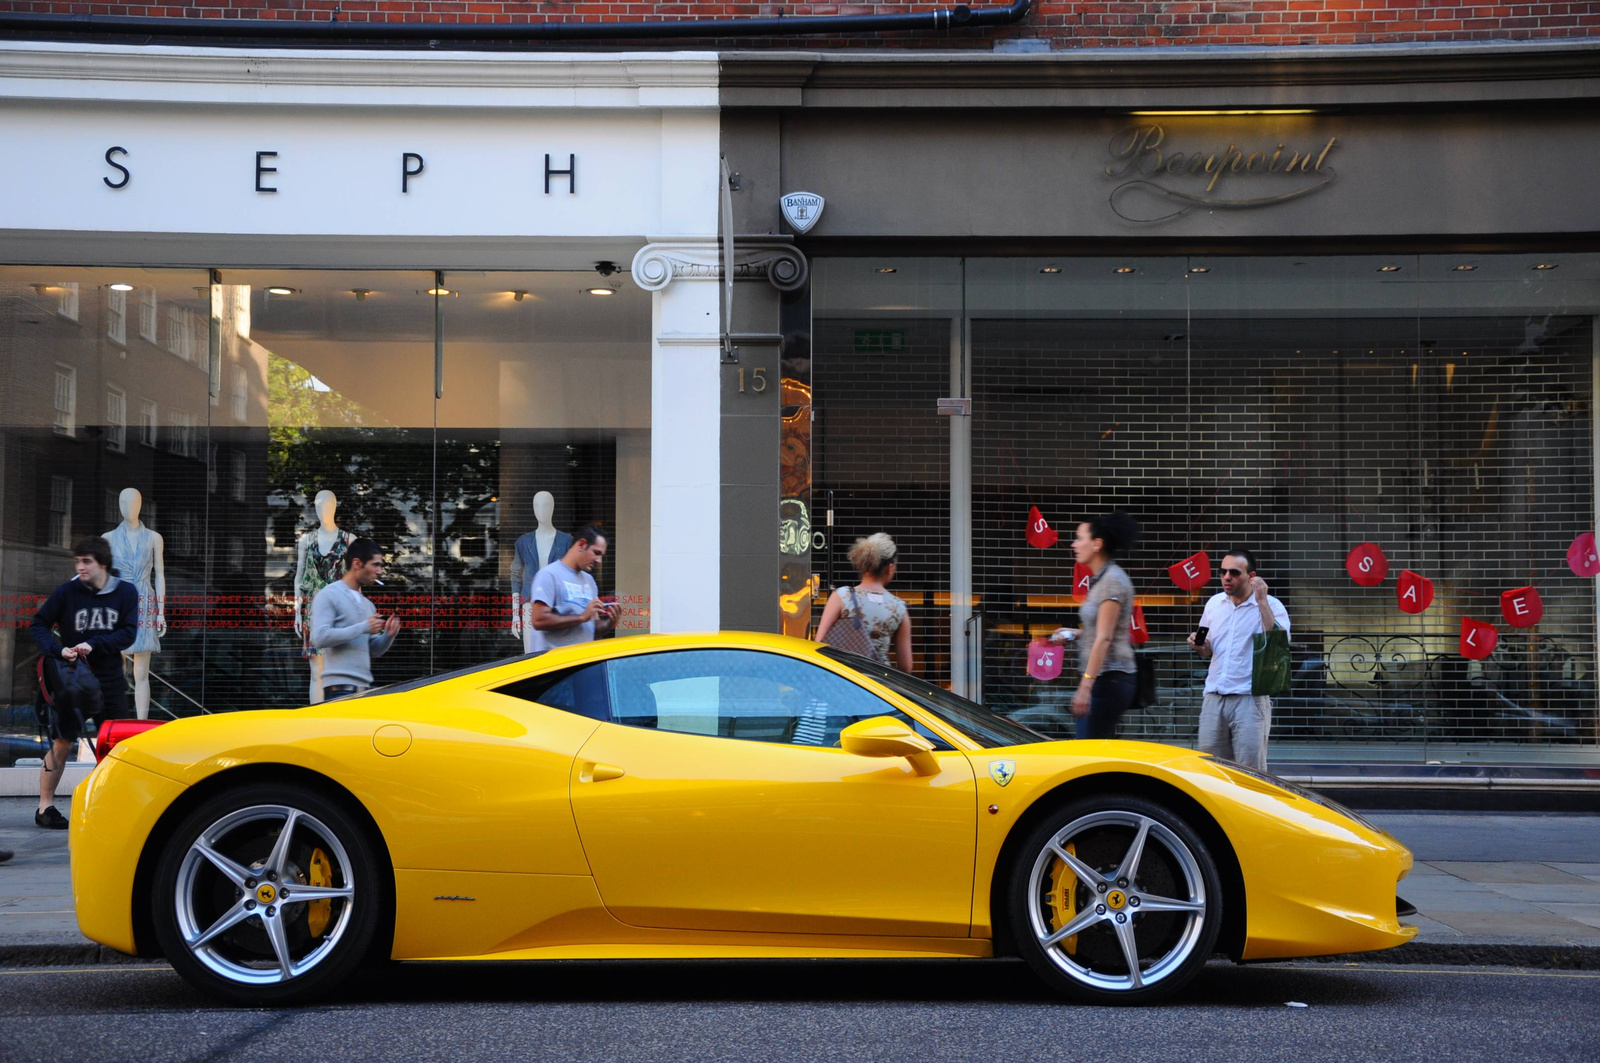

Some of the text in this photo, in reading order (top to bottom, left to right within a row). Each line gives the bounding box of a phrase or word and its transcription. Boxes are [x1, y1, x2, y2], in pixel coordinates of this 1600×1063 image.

[1104, 122, 1341, 196] Bonpoint
[787, 198, 818, 207] BANHAM
[738, 367, 767, 393] 15
[205, 595, 241, 604] SUMMER
[244, 595, 265, 604] SALE
[397, 595, 431, 604] SUMMER
[434, 595, 455, 604] SALE
[459, 595, 490, 604] JOSEPH
[622, 594, 644, 604] SALE
[172, 608, 203, 616] JOSEPH
[206, 608, 240, 616] SUMMER
[243, 608, 264, 616] SALE
[434, 608, 455, 616] SALE
[459, 608, 490, 616] JOSEPH
[491, 608, 525, 616] SUMMER
[622, 607, 644, 616] SALE
[75, 607, 119, 632] GAP
[171, 620, 203, 629] JOSEPH
[205, 620, 240, 629] SUMMER
[243, 620, 264, 629] SALE
[399, 620, 431, 629] UMMER
[434, 620, 455, 629] SALE
[459, 620, 490, 629] JOSEPH
[491, 620, 525, 629] SUMMER
[622, 620, 644, 629] SALE
